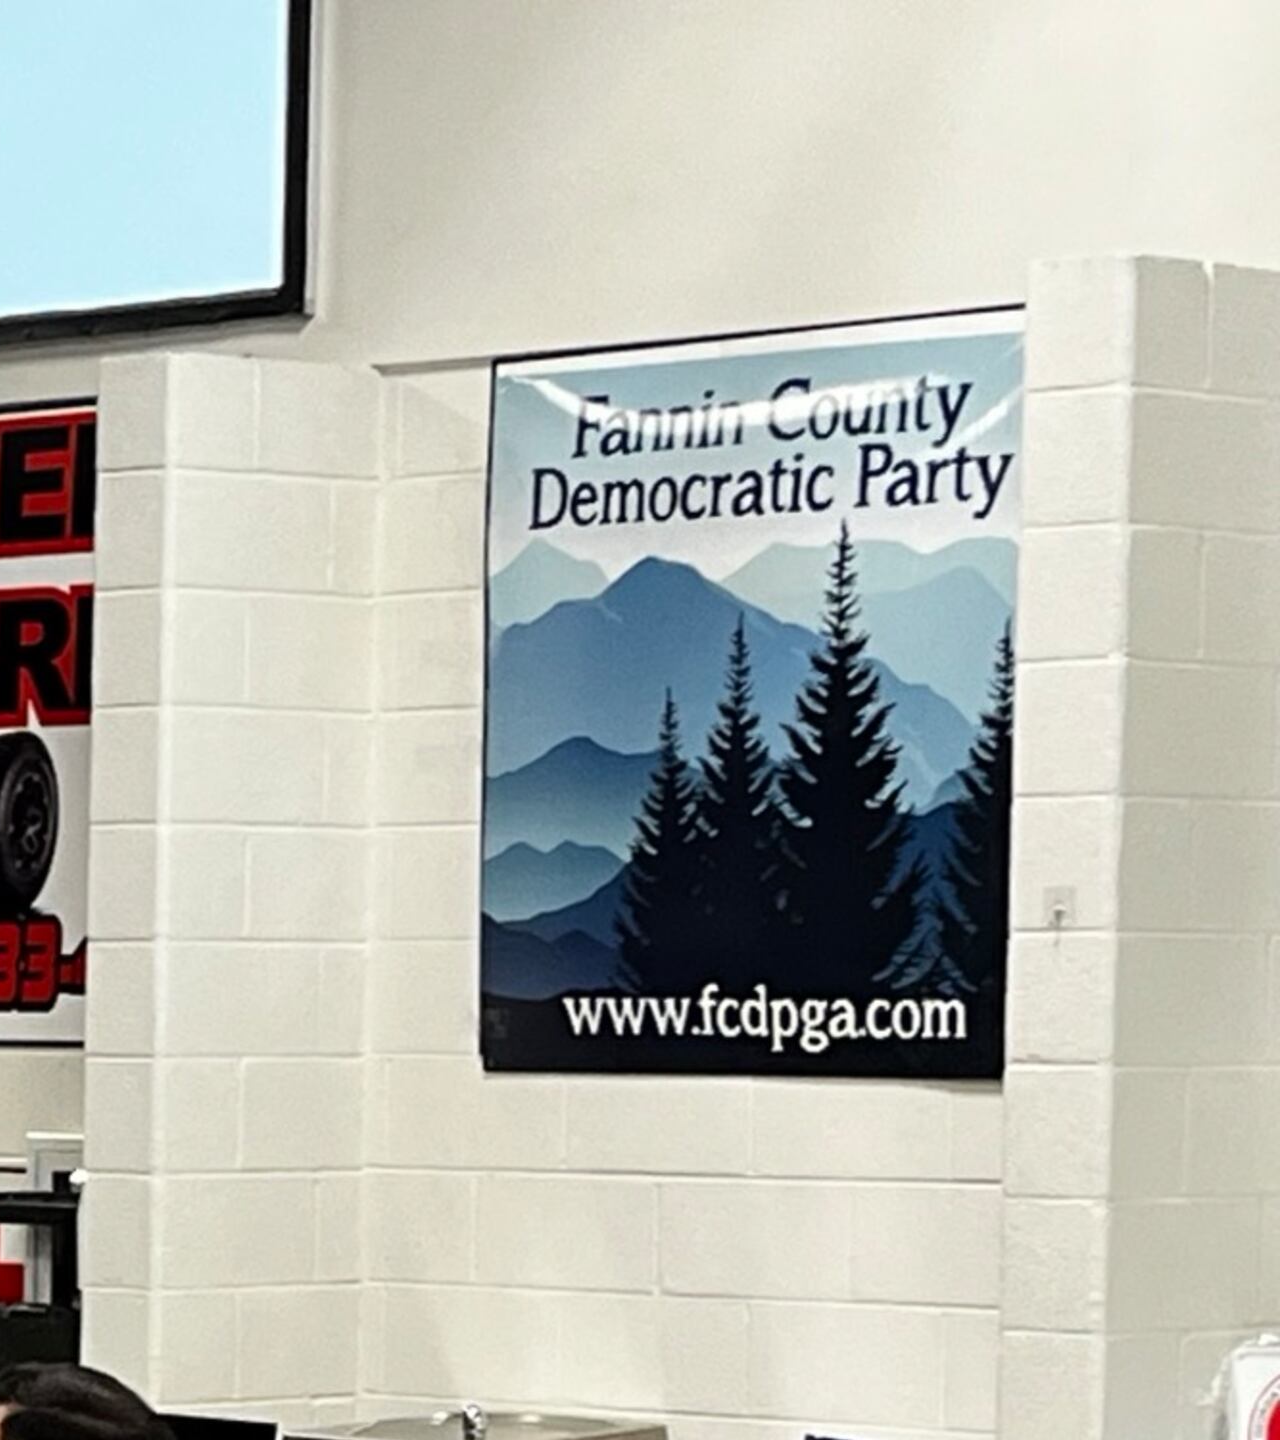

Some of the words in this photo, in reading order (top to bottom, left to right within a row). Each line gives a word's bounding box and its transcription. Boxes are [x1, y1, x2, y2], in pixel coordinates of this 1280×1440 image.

[571, 389, 743, 459] Fannin
[768, 375, 973, 449] County
[529, 453, 836, 531] Democratic
[853, 443, 1016, 519] Party
[562, 983, 969, 1054] www.fcdpga.com
